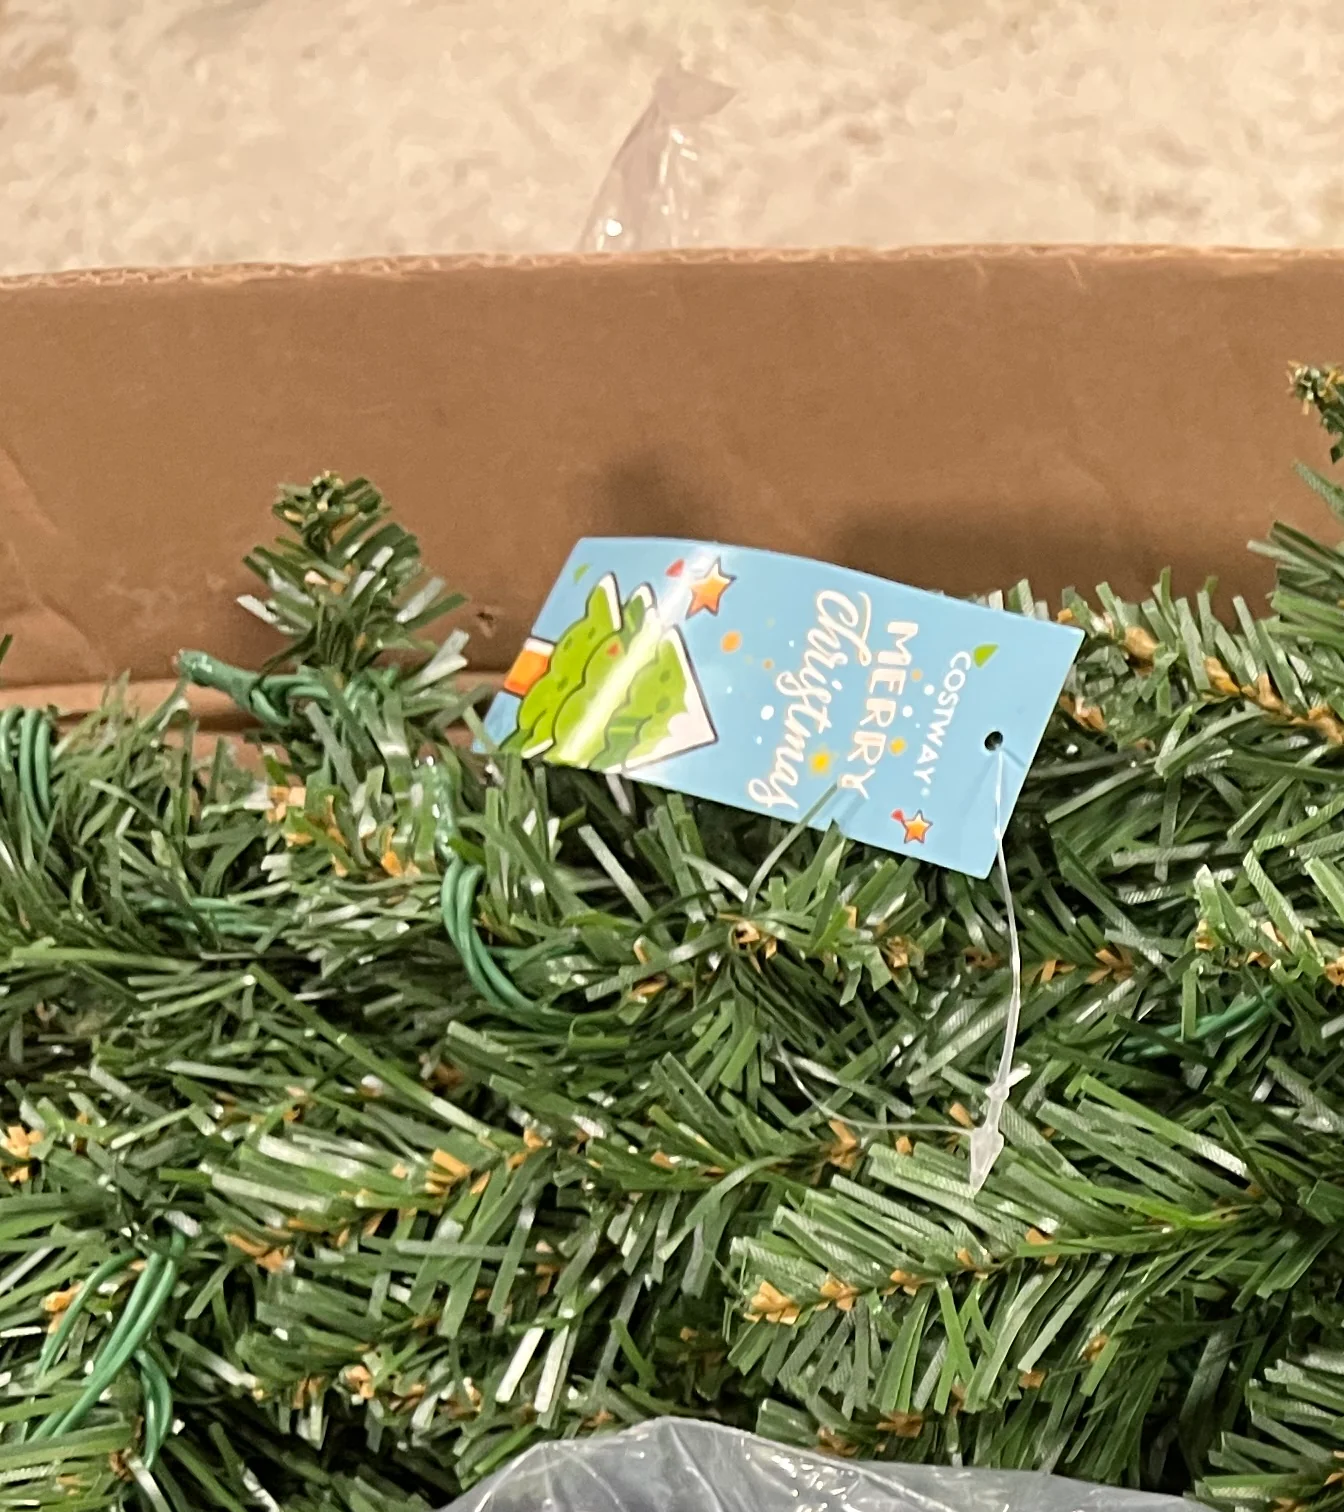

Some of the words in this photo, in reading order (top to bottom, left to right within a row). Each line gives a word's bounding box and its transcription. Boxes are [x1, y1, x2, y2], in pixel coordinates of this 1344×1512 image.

[747, 588, 873, 810] Christmas
[836, 620, 920, 801] MERRY
[913, 650, 972, 785] COSTWAY
